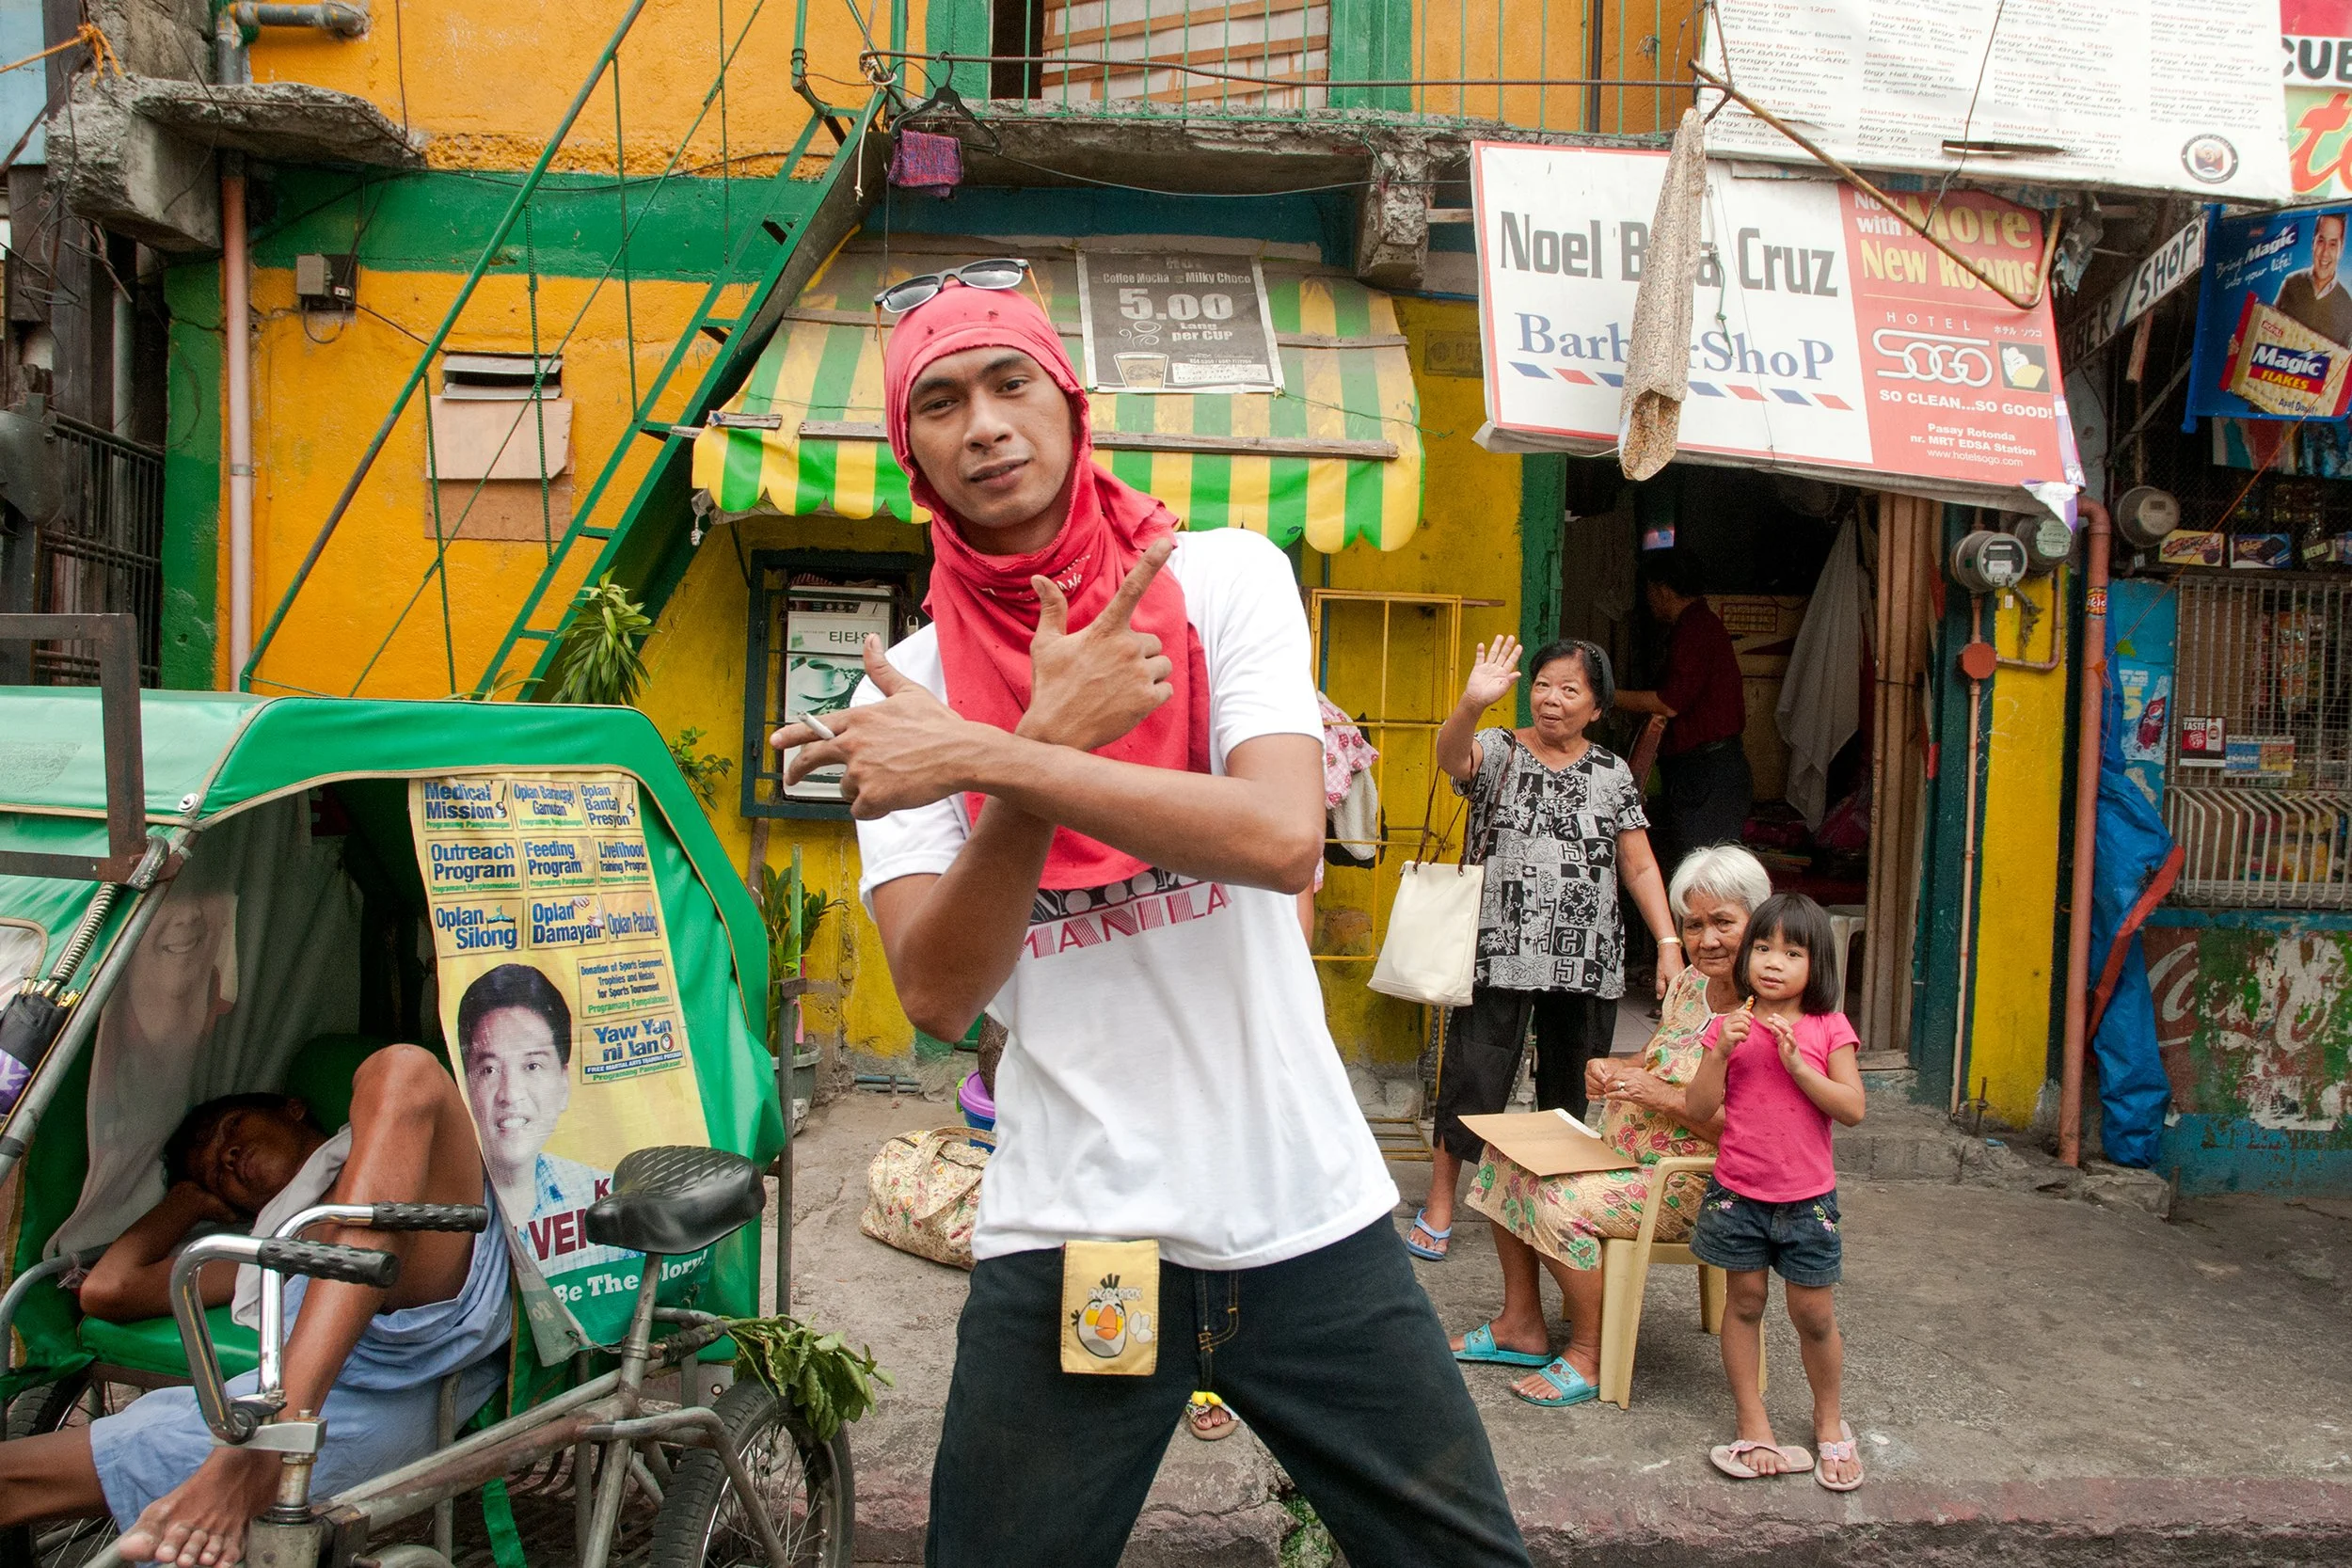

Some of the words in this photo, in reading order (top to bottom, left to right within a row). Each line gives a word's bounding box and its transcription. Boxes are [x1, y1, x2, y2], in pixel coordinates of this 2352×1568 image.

[1724, 7, 1770, 17] Barangay
[1790, 54, 1851, 65] DAYCARE
[1814, 48, 1846, 56] 12pm
[1866, 52, 1905, 61] Saturday
[1860, 107, 1908, 119] Saturday
[1856, 215, 1901, 236] with
[1905, 194, 2033, 249] More
[1501, 211, 1603, 279] Noel
[1738, 228, 1837, 297] Cruz
[2244, 231, 2296, 264] Magic
[1861, 240, 1928, 284] New
[1937, 246, 2037, 295] Rooms
[2137, 223, 2200, 309] SHOP
[1103, 272, 1136, 284] Coffee
[1136, 272, 1170, 284] Mocha
[1185, 271, 1216, 285] Milky
[1216, 272, 1251, 284] Choco
[1119, 288, 1233, 321] 5.00
[1886, 311, 1971, 332] HOTEL
[1171, 331, 1200, 341] per
[1201, 330, 1233, 341] CUP
[1872, 327, 1993, 388] SOGO
[2251, 344, 2323, 377] Magic
[2260, 370, 2311, 390] FLAKES
[1880, 388, 1902, 403] SO
[2002, 404, 2054, 420] GOOD!
[1928, 423, 1964, 437] Pasay
[1967, 427, 2016, 441] Rotonda
[1910, 434, 1925, 444] nr.
[1929, 436, 1956, 449] MRT
[1958, 439, 1991, 451] EDSA
[1994, 442, 2037, 456] Station
[1927, 449, 2024, 467] www.hotelsogo.com
[2183, 721, 2206, 731] TASTE
[424, 782, 492, 801] Medical
[514, 784, 539, 802] Oplan
[580, 784, 612, 797] Oplan
[425, 801, 495, 819] Mission
[583, 798, 621, 814] Bantay
[587, 812, 630, 829] Presyon
[431, 842, 515, 863] Outreach
[524, 840, 576, 861] Feeding
[598, 841, 645, 859] Livelihood
[433, 863, 516, 883] Program
[527, 858, 583, 879] Program
[436, 906, 485, 932] Oplan
[532, 903, 575, 926] Oplan
[608, 912, 632, 937] Oplan
[455, 927, 518, 950] Silong
[532, 925, 602, 944] Damayan
[580, 963, 610, 975] Donation
[611, 961, 618, 971] of
[619, 961, 638, 972] Sports
[628, 973, 638, 981] and
[597, 987, 608, 999] for
[609, 985, 629, 998] Sports
[594, 1025, 639, 1045] Yaw
[641, 1018, 673, 1036] Yan
[603, 1043, 624, 1062] ni
[587, 1065, 606, 1073] FREE
[552, 1283, 583, 1305] Be
[587, 1273, 640, 1297] The
[658, 1249, 708, 1283] lory!
